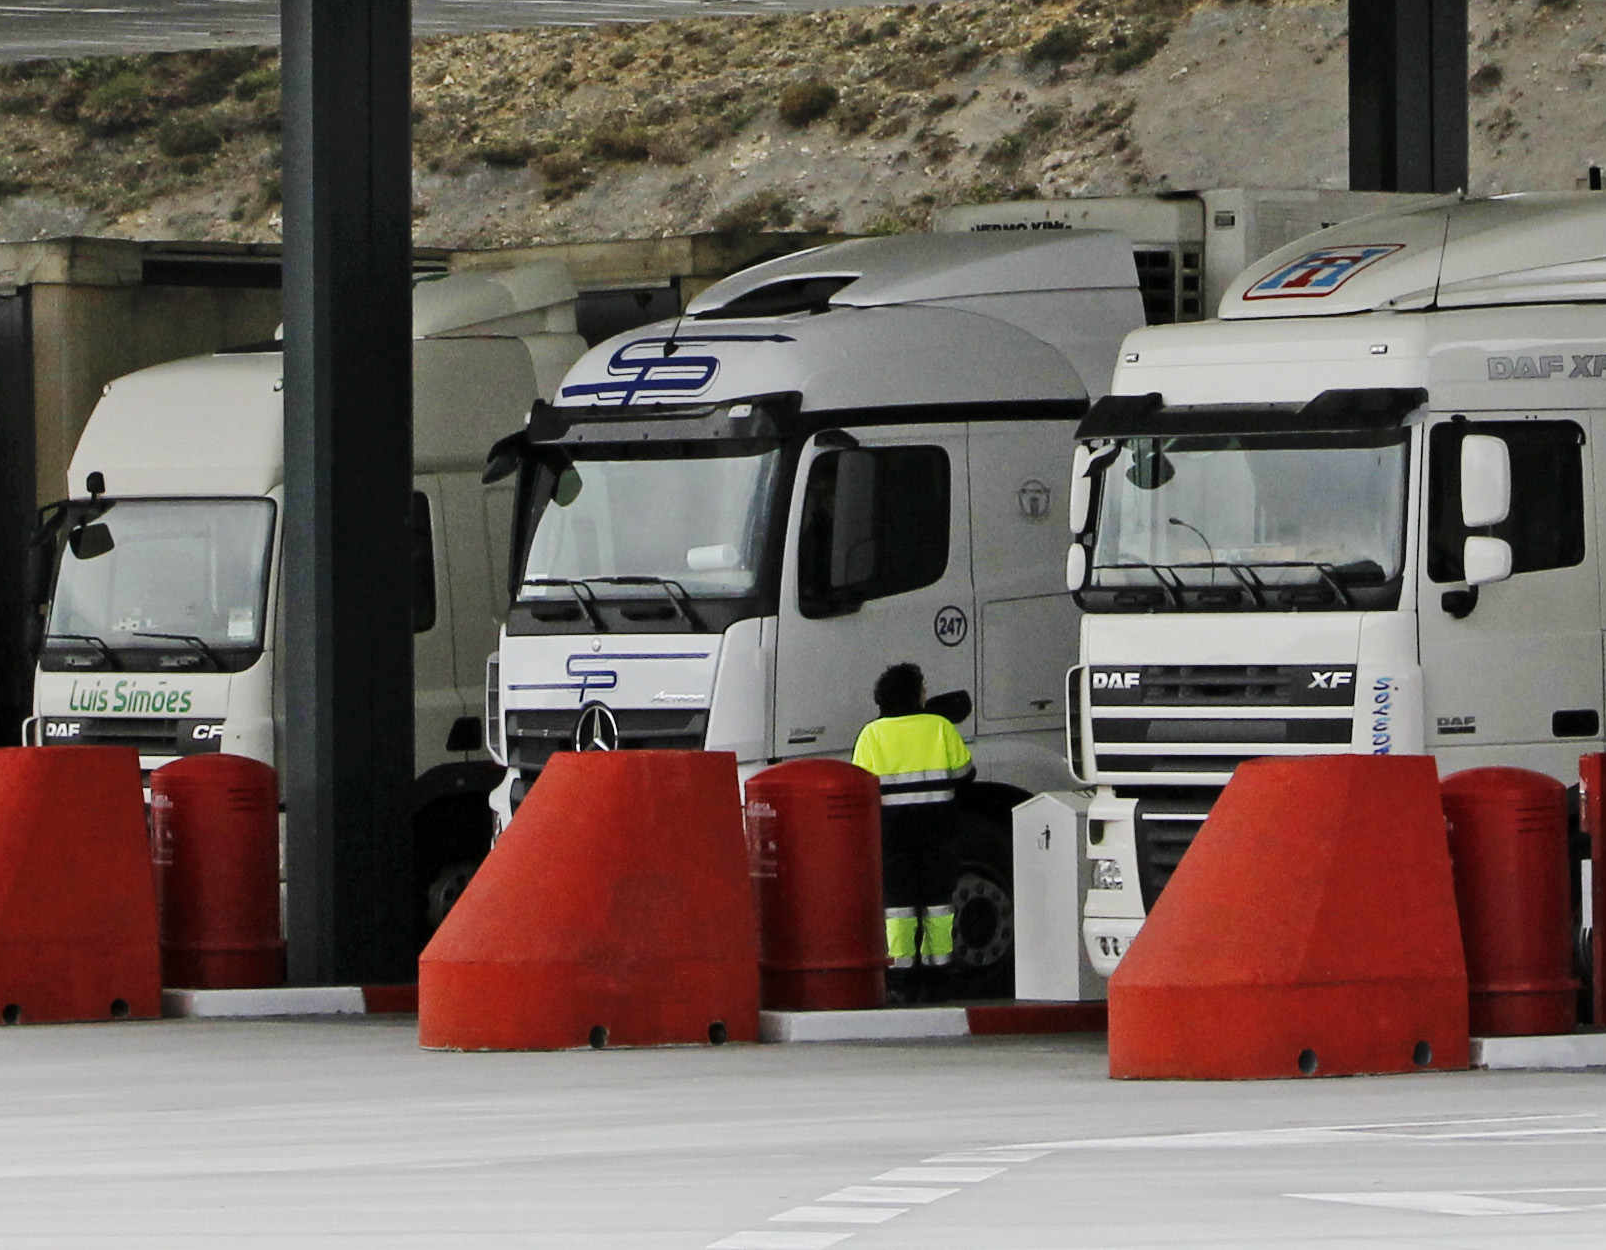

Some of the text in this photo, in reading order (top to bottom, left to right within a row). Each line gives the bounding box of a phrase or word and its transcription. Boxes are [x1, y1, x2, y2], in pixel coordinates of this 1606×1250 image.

[1487, 355, 1564, 380] DAF
[938, 616, 963, 637] 247
[1092, 671, 1141, 690] DAF
[1307, 671, 1353, 689] XF
[112, 680, 192, 713] Simões
[45, 722, 80, 738] DAF
[192, 724, 224, 740] CF
